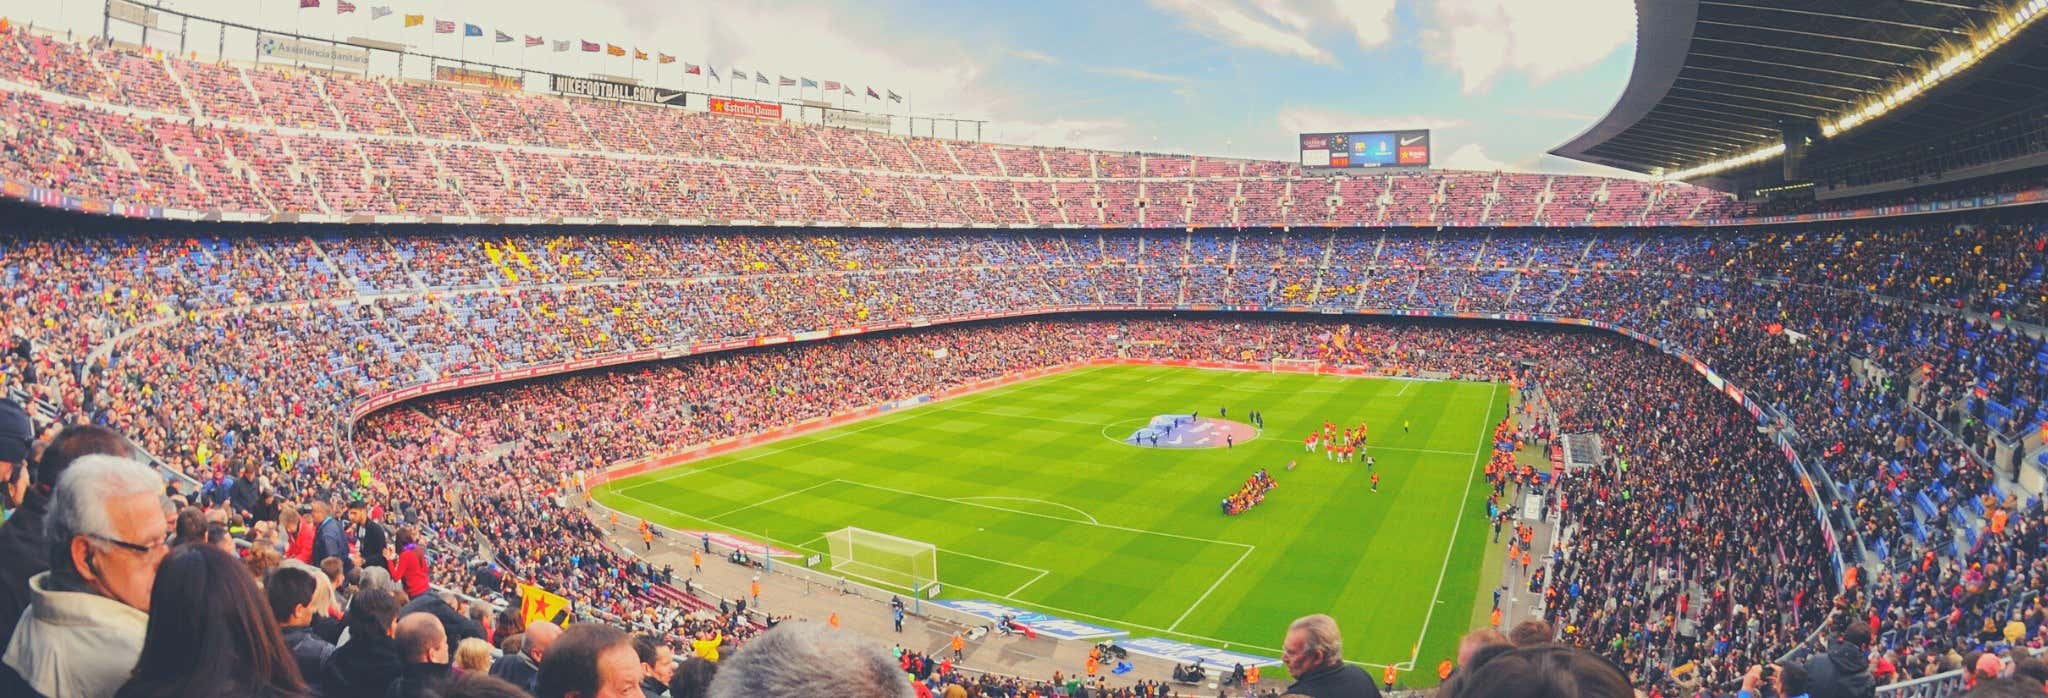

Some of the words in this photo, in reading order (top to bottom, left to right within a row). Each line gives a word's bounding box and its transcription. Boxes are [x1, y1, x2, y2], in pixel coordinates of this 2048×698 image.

[556, 76, 656, 102] NIKEFOOTBALL.COM
[724, 100, 754, 114] Estrella
[754, 103, 779, 117] Damm
